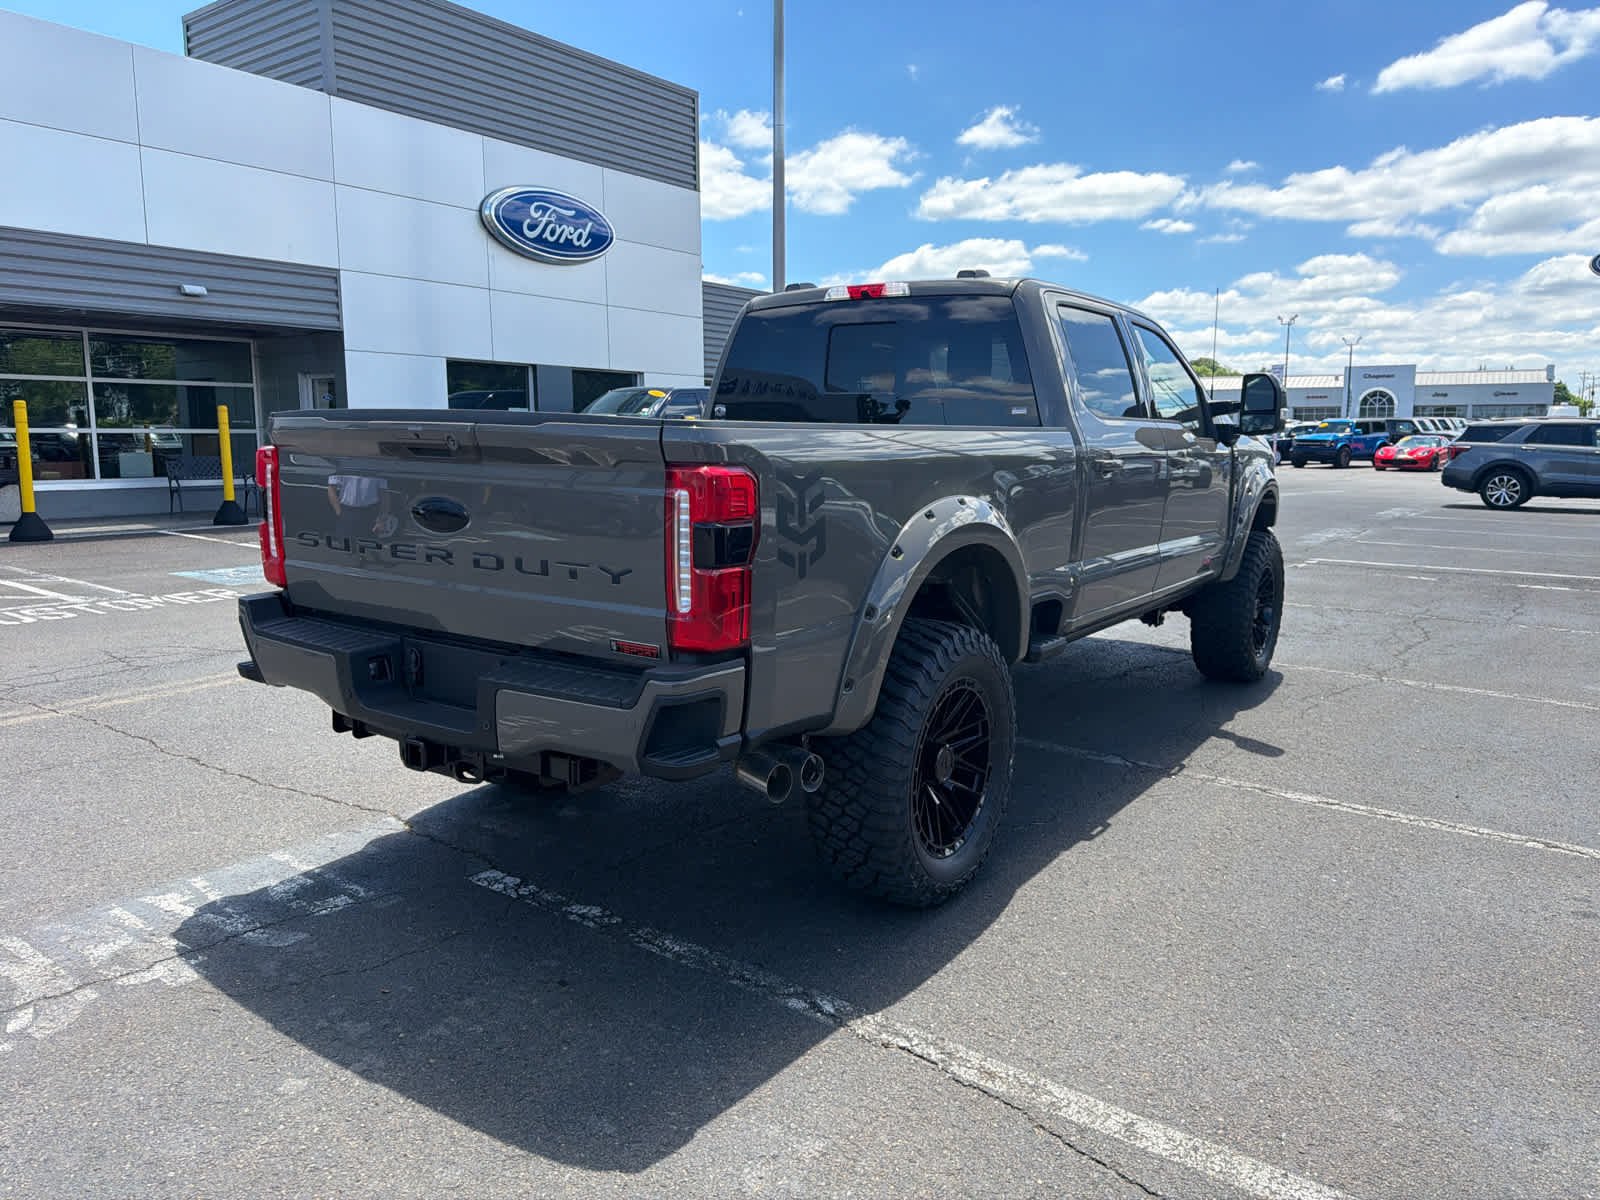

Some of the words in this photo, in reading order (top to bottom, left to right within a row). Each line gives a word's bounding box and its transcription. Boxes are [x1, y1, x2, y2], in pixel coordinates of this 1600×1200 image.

[522, 201, 594, 248] Ford
[296, 530, 456, 567] SUPER
[471, 551, 634, 586] DUTY
